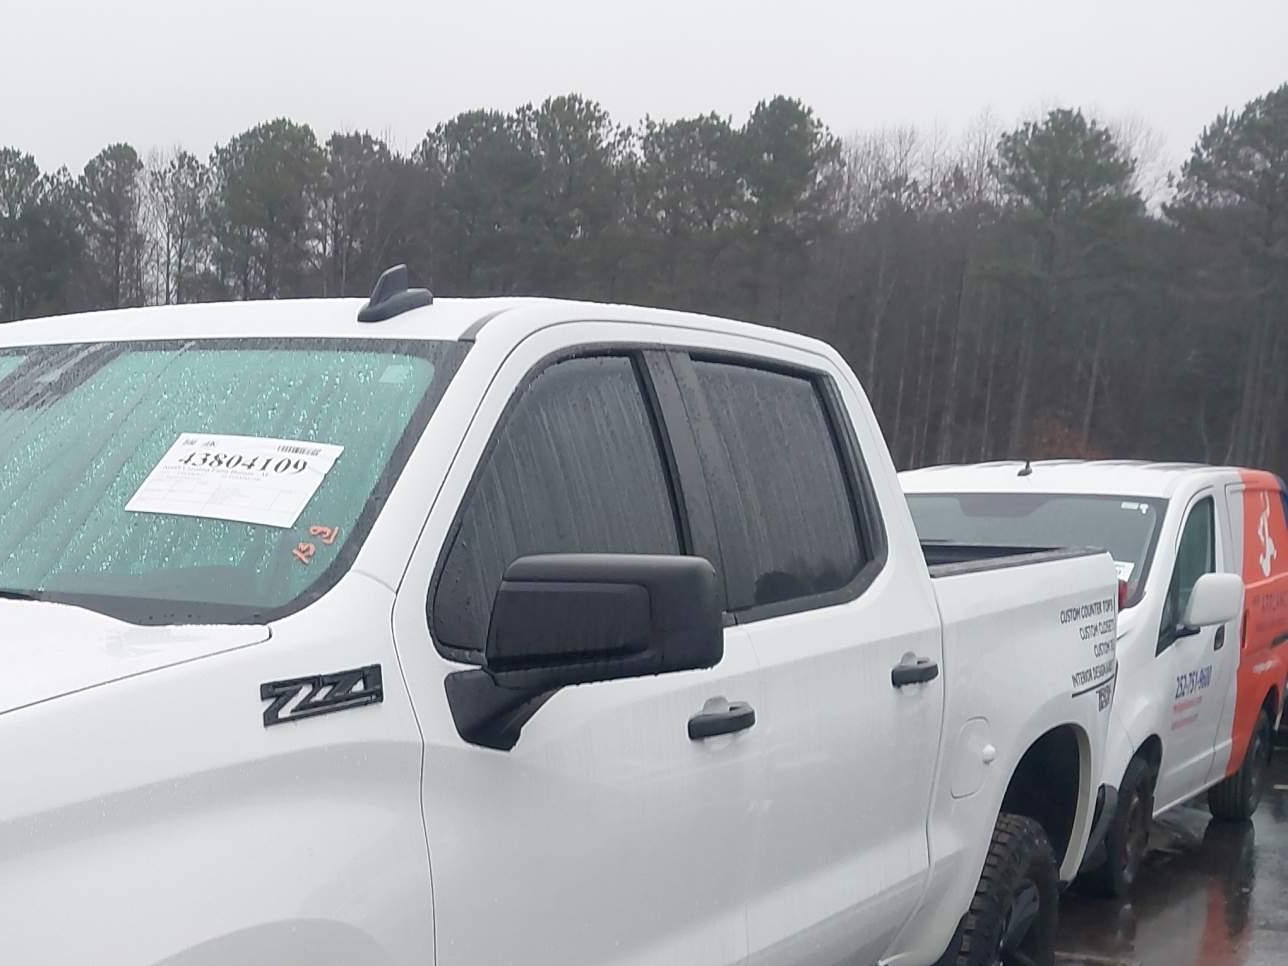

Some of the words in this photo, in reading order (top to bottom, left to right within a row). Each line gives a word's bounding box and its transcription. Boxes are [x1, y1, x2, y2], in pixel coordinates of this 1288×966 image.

[177, 451, 309, 475] 43804109
[1060, 607, 1080, 624] CUSTOM
[1081, 601, 1102, 619] COUNTER
[1079, 624, 1098, 640] CUSTOM
[1093, 641, 1110, 658] CUSTOM
[1071, 668, 1093, 688] INTERIOR
